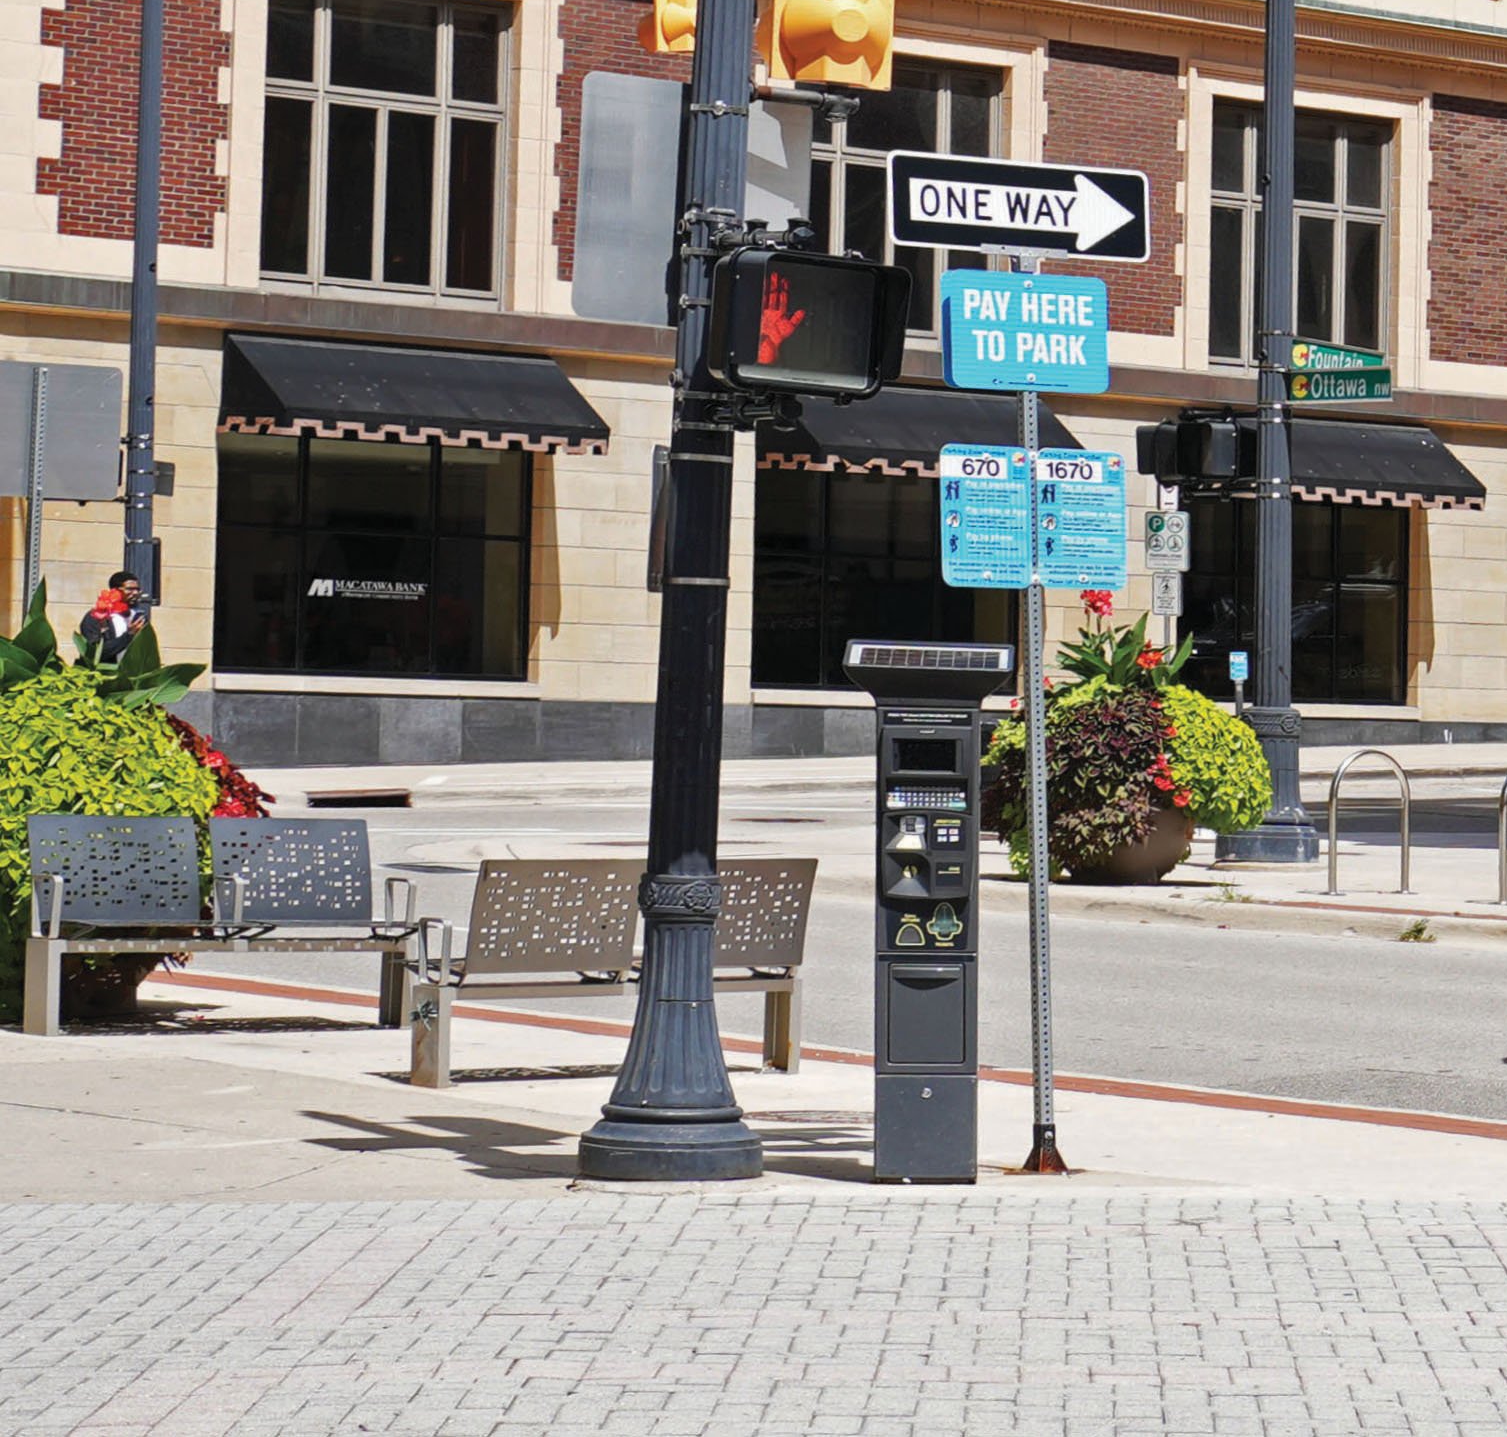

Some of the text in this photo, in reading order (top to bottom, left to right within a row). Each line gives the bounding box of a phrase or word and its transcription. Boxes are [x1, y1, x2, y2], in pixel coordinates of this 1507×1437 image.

[919, 184, 1077, 227] ONE WAY
[963, 288, 1094, 327] PAY HERE
[971, 329, 1087, 366] TO PARK
[1307, 344, 1364, 368] Fountain
[1310, 373, 1390, 399] Ottawa nw
[961, 458, 1000, 477] 670
[1046, 461, 1094, 480] 1670
[334, 579, 426, 595] MACATAWA BANK
